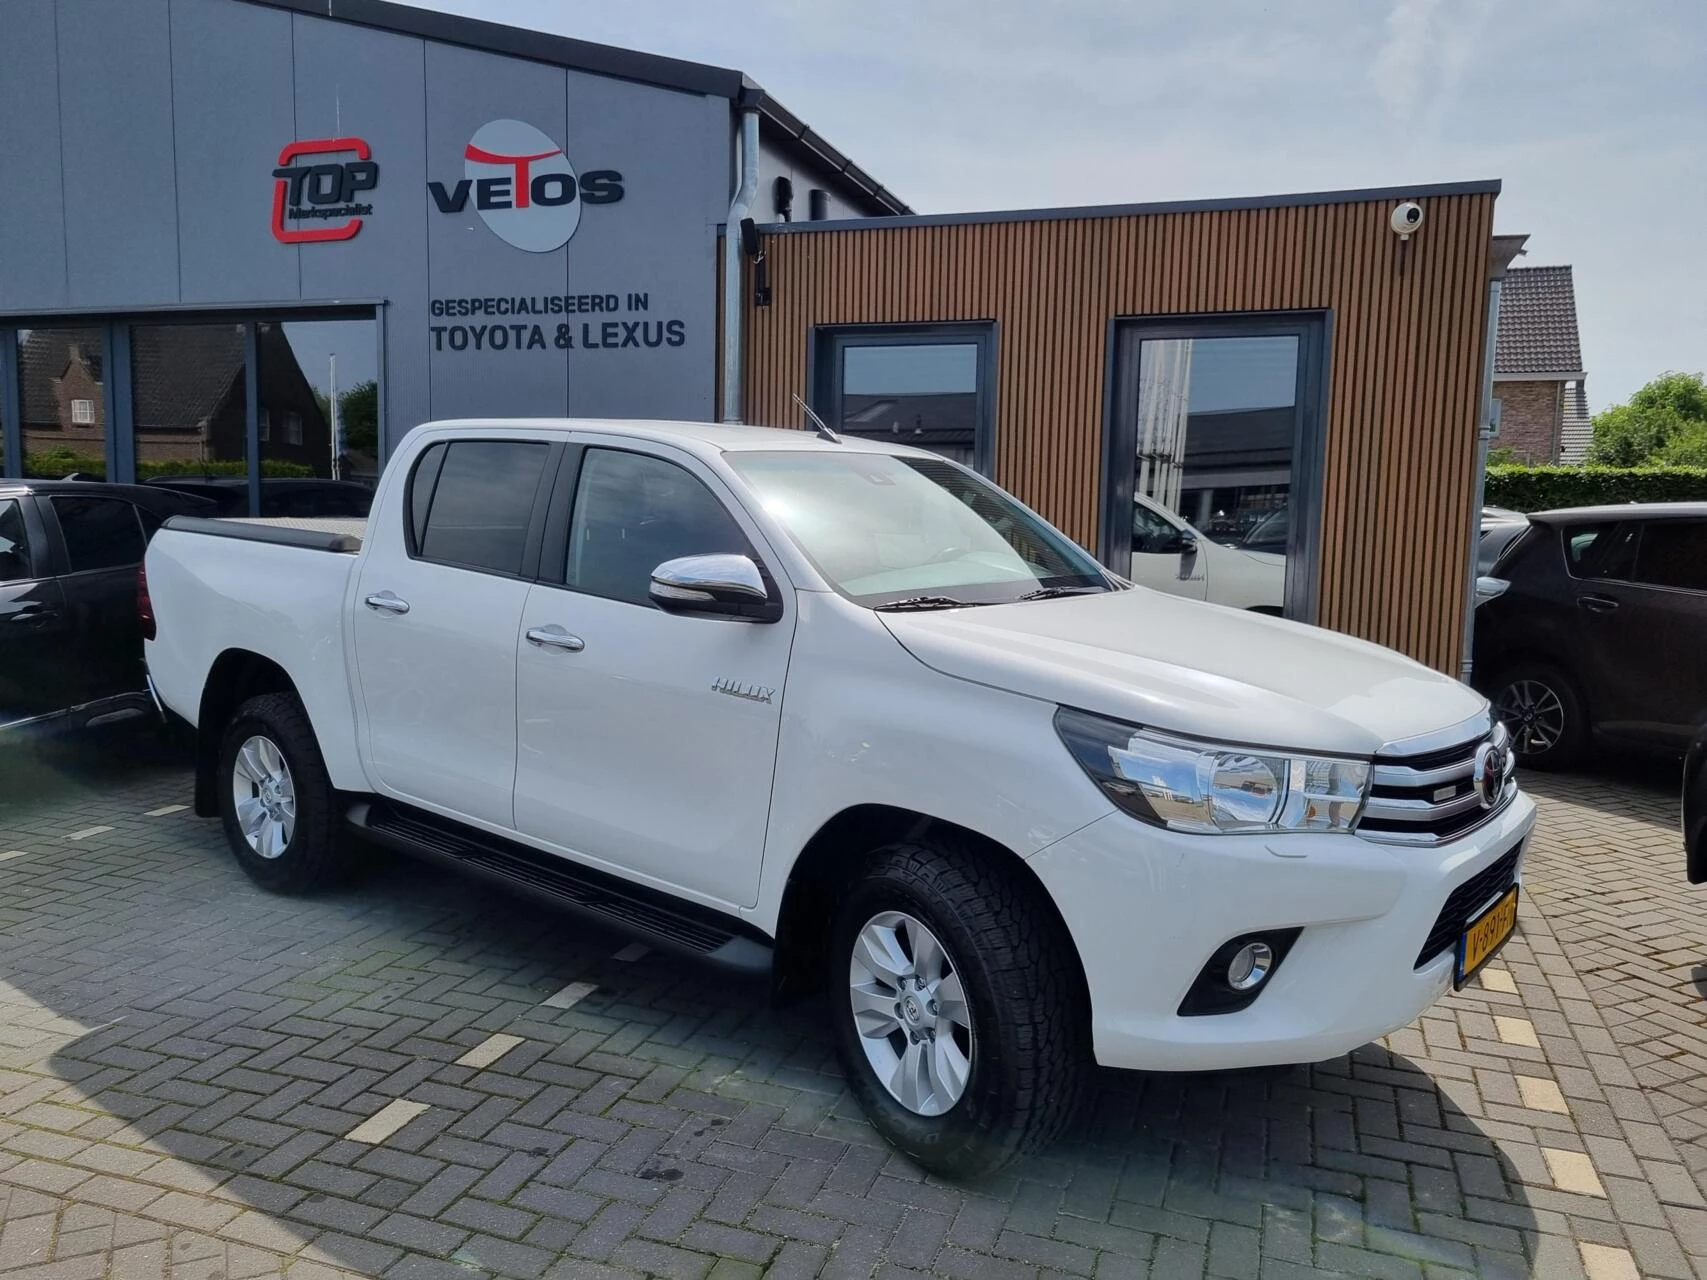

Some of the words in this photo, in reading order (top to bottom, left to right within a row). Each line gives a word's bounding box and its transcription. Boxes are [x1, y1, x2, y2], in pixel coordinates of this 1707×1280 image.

[272, 162, 380, 206] TOP
[427, 145, 625, 214] VETOS
[430, 296, 619, 317] GESPECIALISEERD
[626, 293, 648, 311] IN
[430, 323, 546, 351] TOYOTA
[553, 323, 574, 349] &
[582, 320, 686, 349] LEXUS
[711, 675, 776, 704] HILUX
